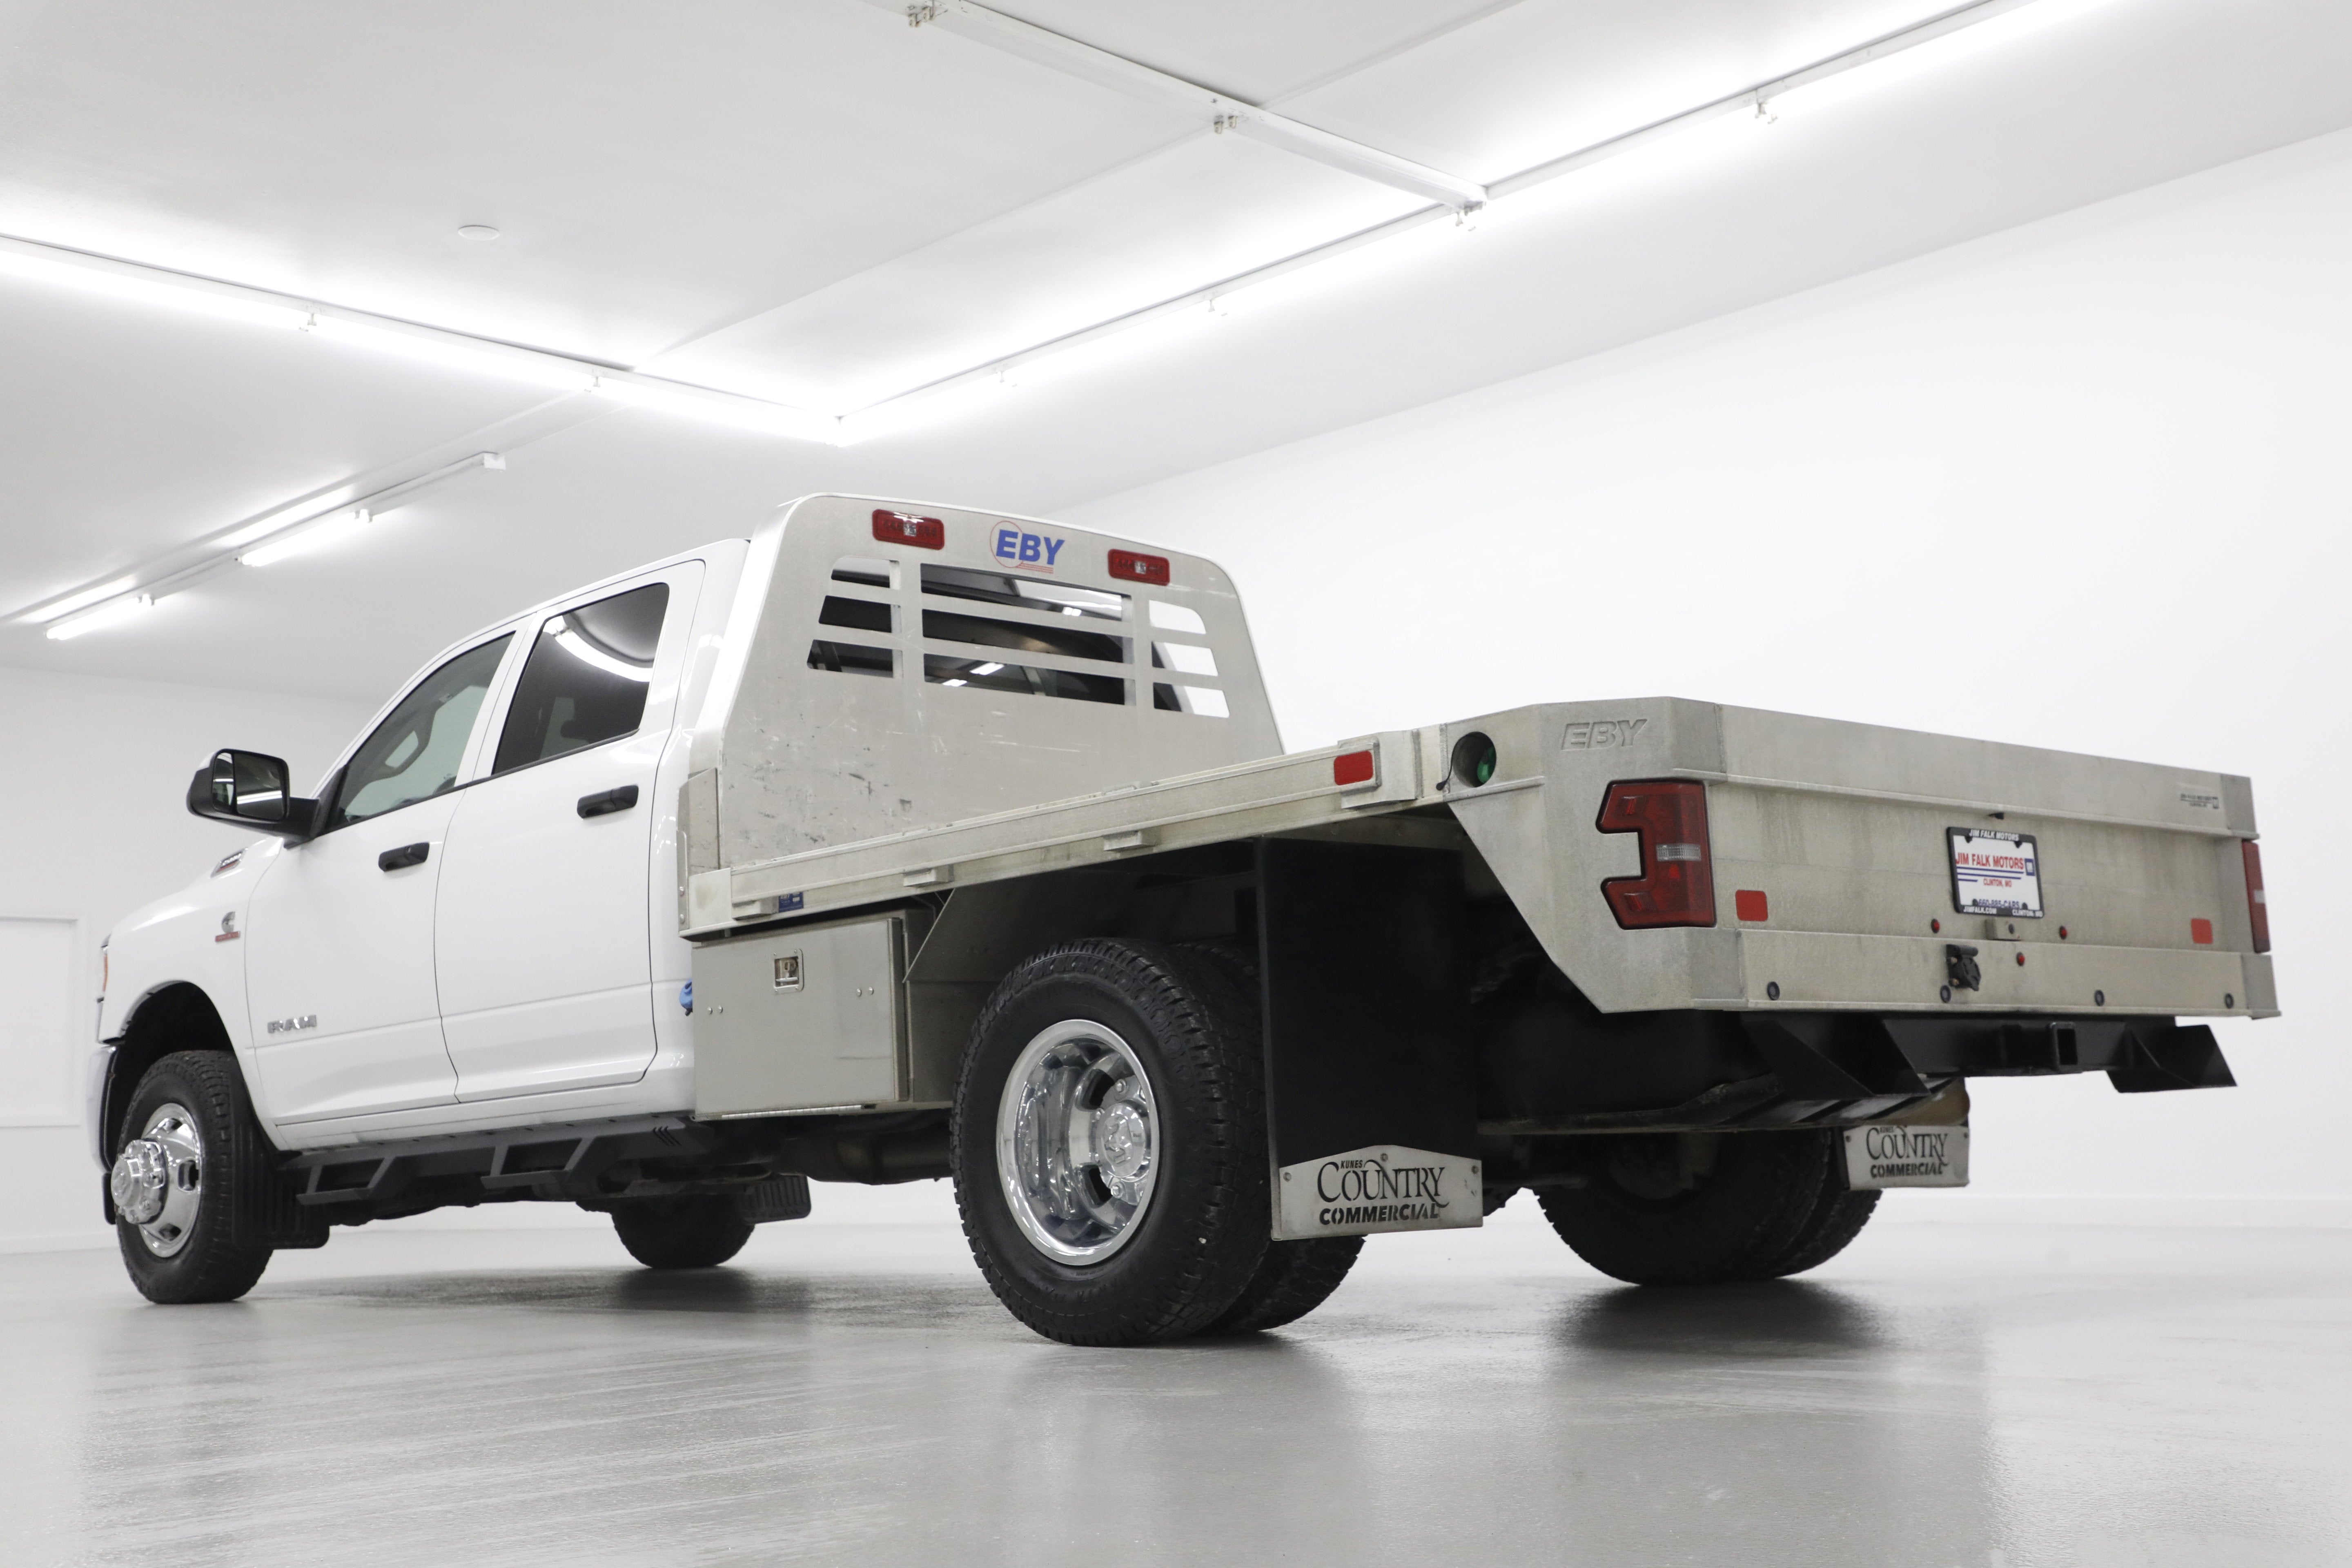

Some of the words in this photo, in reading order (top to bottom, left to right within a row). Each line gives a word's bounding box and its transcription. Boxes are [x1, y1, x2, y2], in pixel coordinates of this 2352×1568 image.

[995, 529, 1065, 565] EBY
[1561, 719, 1647, 751] EBY
[1980, 829, 1995, 839] FALK
[1996, 831, 2019, 841] MOTORS
[1956, 853, 1969, 865] JIM
[1972, 854, 1990, 867] FALK
[1993, 855, 2024, 869] MOTORS
[267, 1015, 316, 1033] RAM
[1341, 1160, 1363, 1169] KUNES
[1871, 1163, 1944, 1179] COMMERCIAL
[1319, 1203, 1439, 1225] COMMERCIAL
